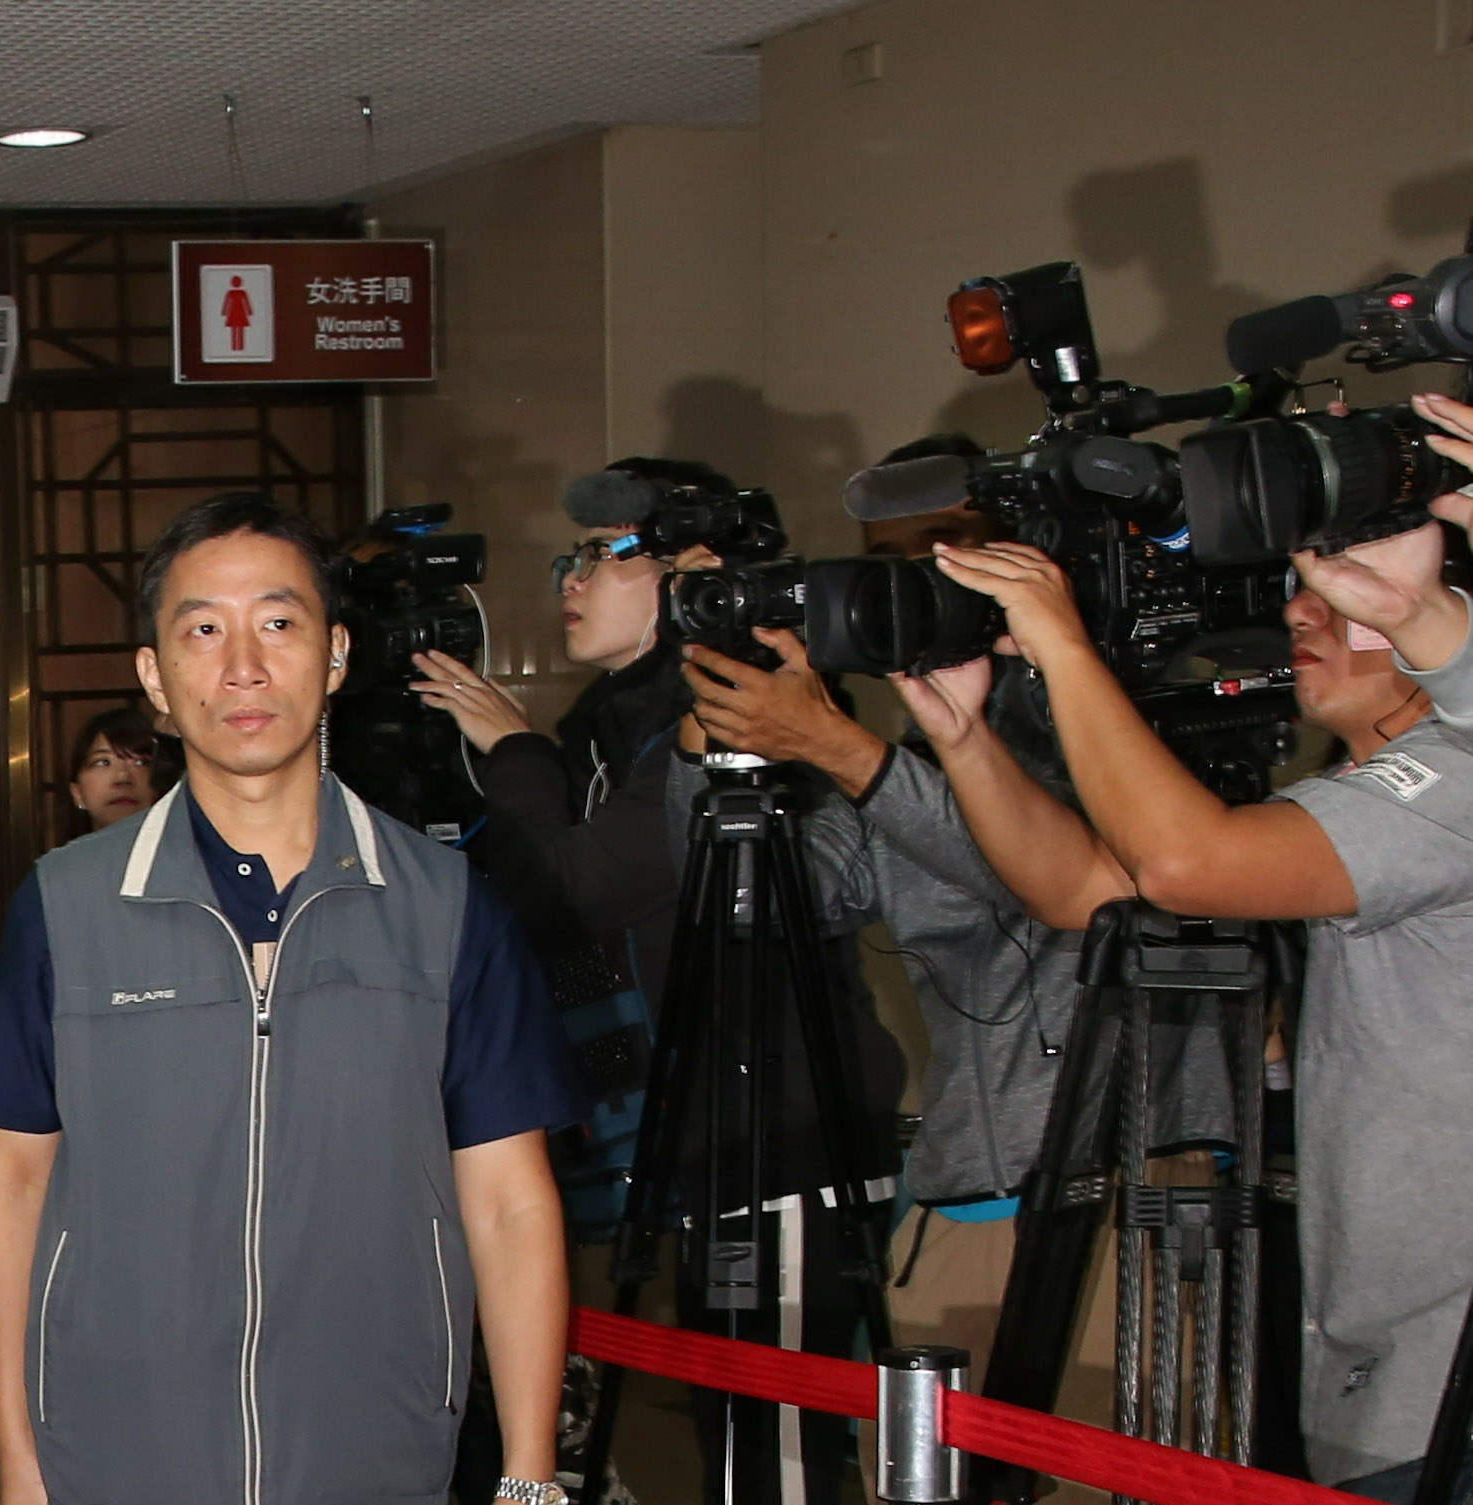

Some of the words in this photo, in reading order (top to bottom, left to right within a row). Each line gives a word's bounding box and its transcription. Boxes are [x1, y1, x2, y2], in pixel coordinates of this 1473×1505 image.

[305, 276, 413, 305] 女洗手間
[316, 315, 402, 333] Women's
[314, 333, 405, 350] Restroom
